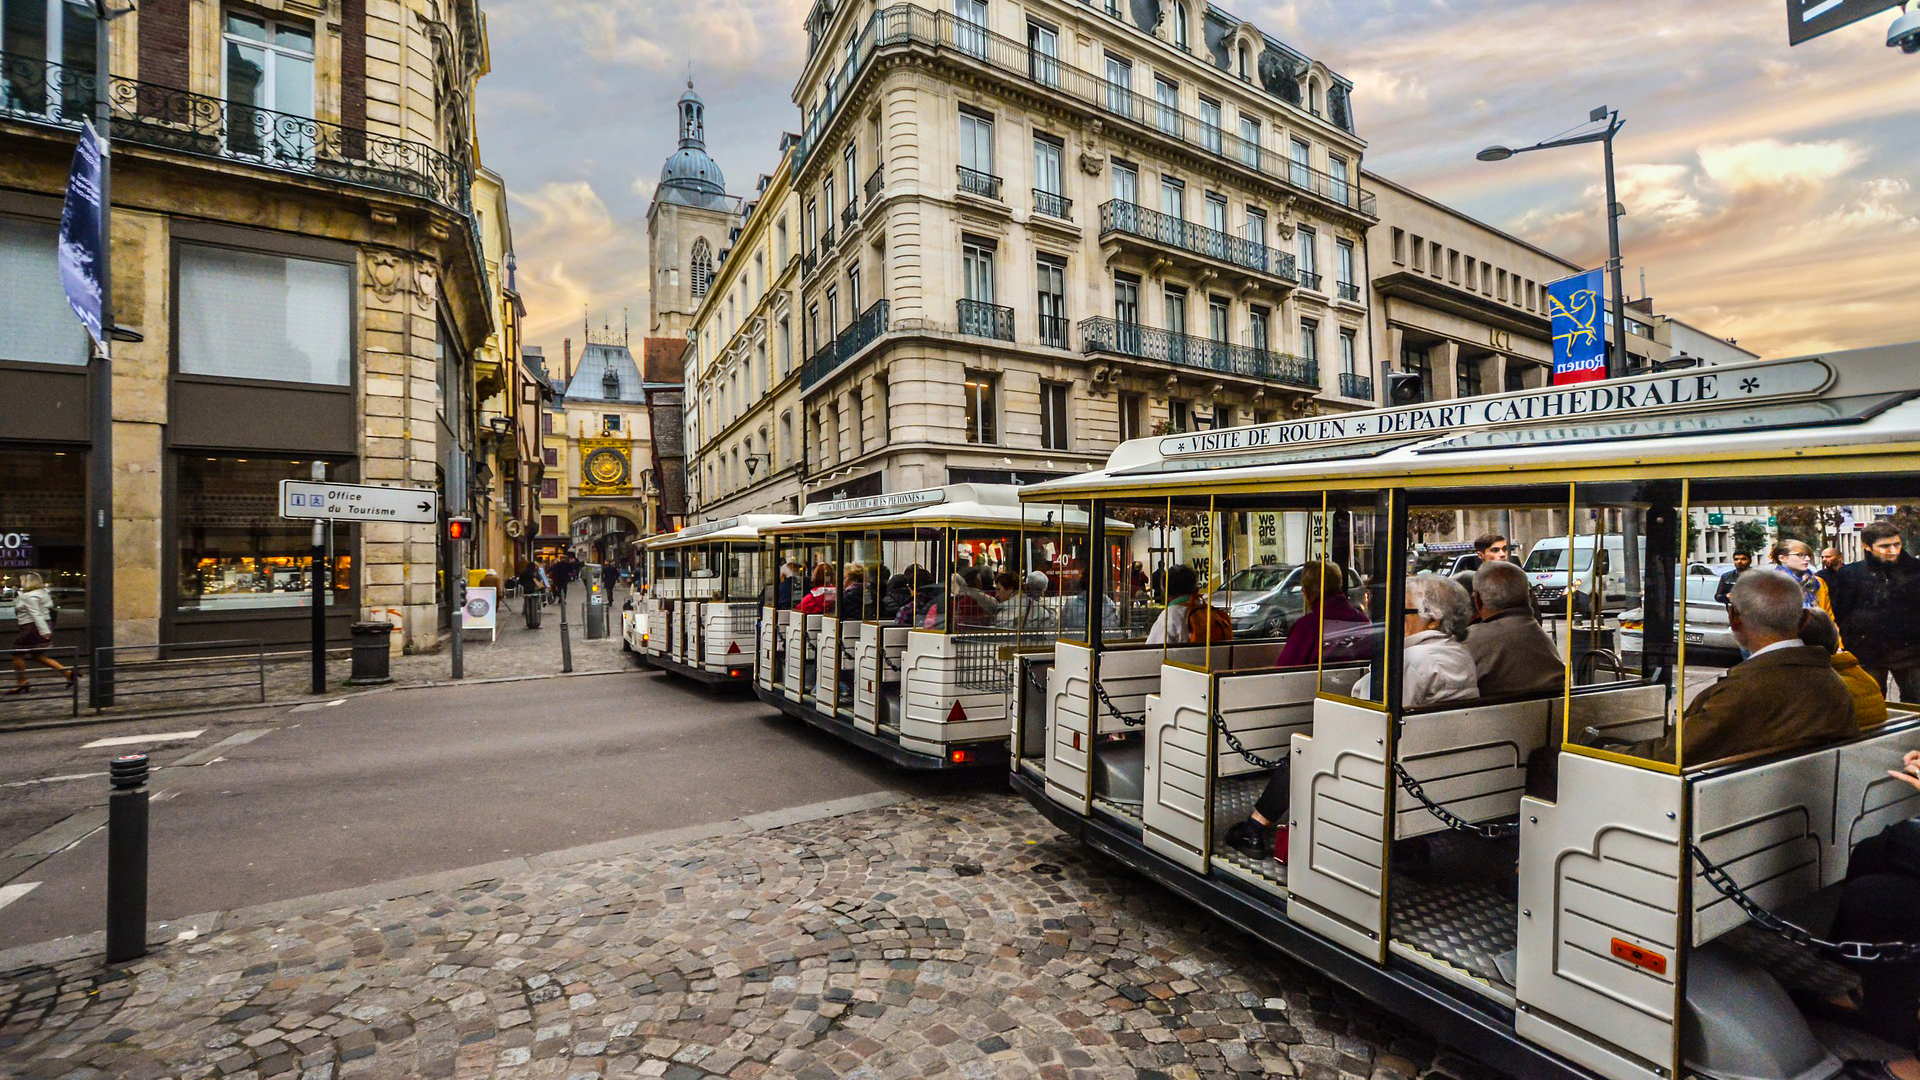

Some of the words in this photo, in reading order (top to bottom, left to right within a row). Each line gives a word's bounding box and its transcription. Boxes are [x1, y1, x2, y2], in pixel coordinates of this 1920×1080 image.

[1490, 328, 1514, 351] LCL
[1192, 431, 1241, 451] VISITE
[1248, 428, 1270, 446] DE
[1280, 420, 1346, 443] ROUEN
[1378, 405, 1472, 433] DEPART
[1484, 374, 1719, 423] CATHEDRALE
[328, 491, 362, 500] Office
[873, 498, 887, 507] RUES
[328, 504, 341, 513] du
[349, 505, 396, 516] Tourisme
[1259, 514, 1275, 526] we
[1314, 515, 1327, 526] w
[1191, 525, 1210, 538] are
[1259, 525, 1276, 537] are
[1193, 557, 1209, 569] we
[1261, 554, 1276, 566] we
